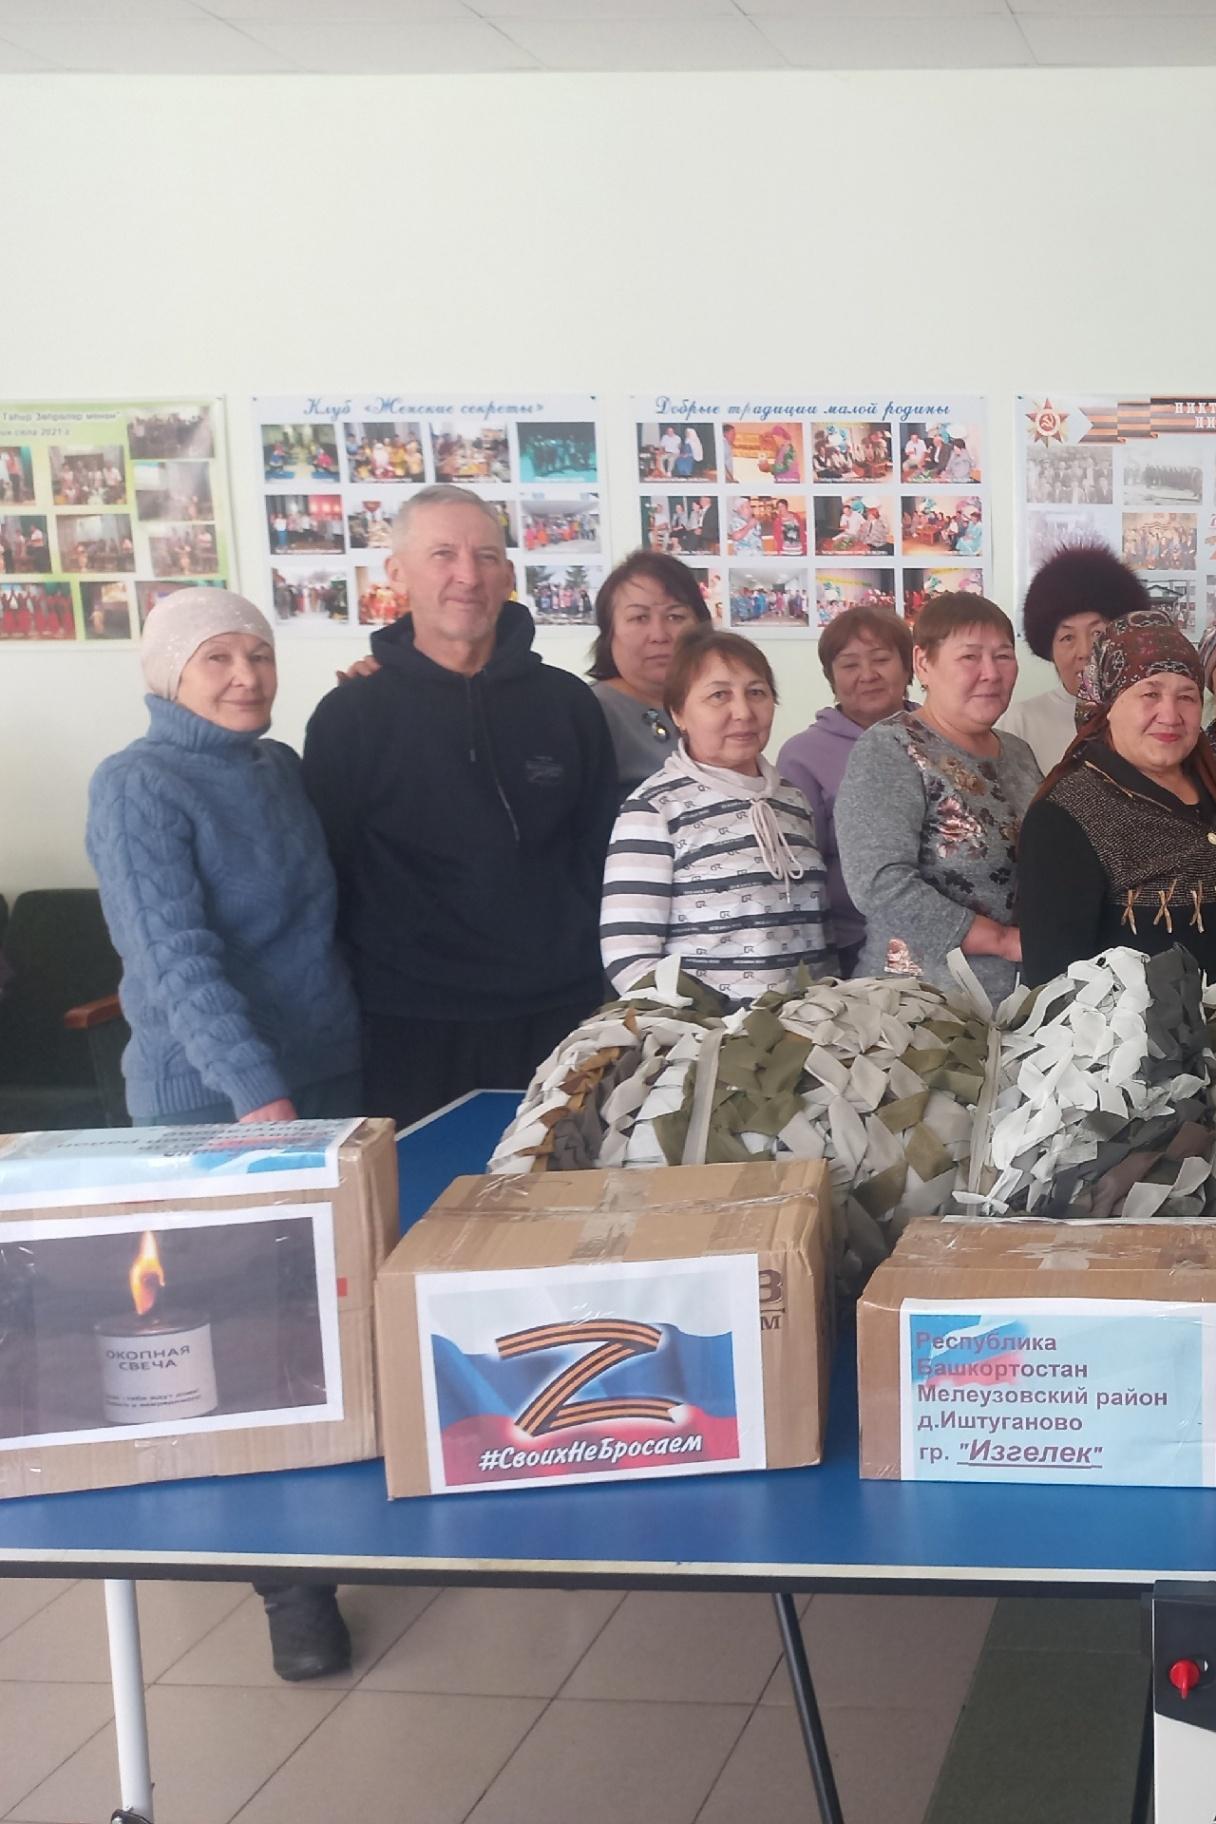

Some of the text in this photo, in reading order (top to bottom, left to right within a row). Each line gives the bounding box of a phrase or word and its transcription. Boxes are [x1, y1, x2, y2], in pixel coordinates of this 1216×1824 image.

[303, 397, 351, 421] Клуб
[655, 395, 950, 421] Добрые традиции малой родины
[105, 1345, 191, 1360] ОКОПНАЯ
[914, 1331, 1058, 1354] Республика
[118, 1359, 178, 1371] СВЕЧА
[916, 1357, 1089, 1382] Башкортостан
[917, 1385, 1169, 1410] Мелеузовский район
[917, 1410, 1084, 1434] д.Иштуганово
[478, 1434, 704, 1472] #СвоихНеБросаем
[919, 1438, 1104, 1466] гр. "Изгелек"
